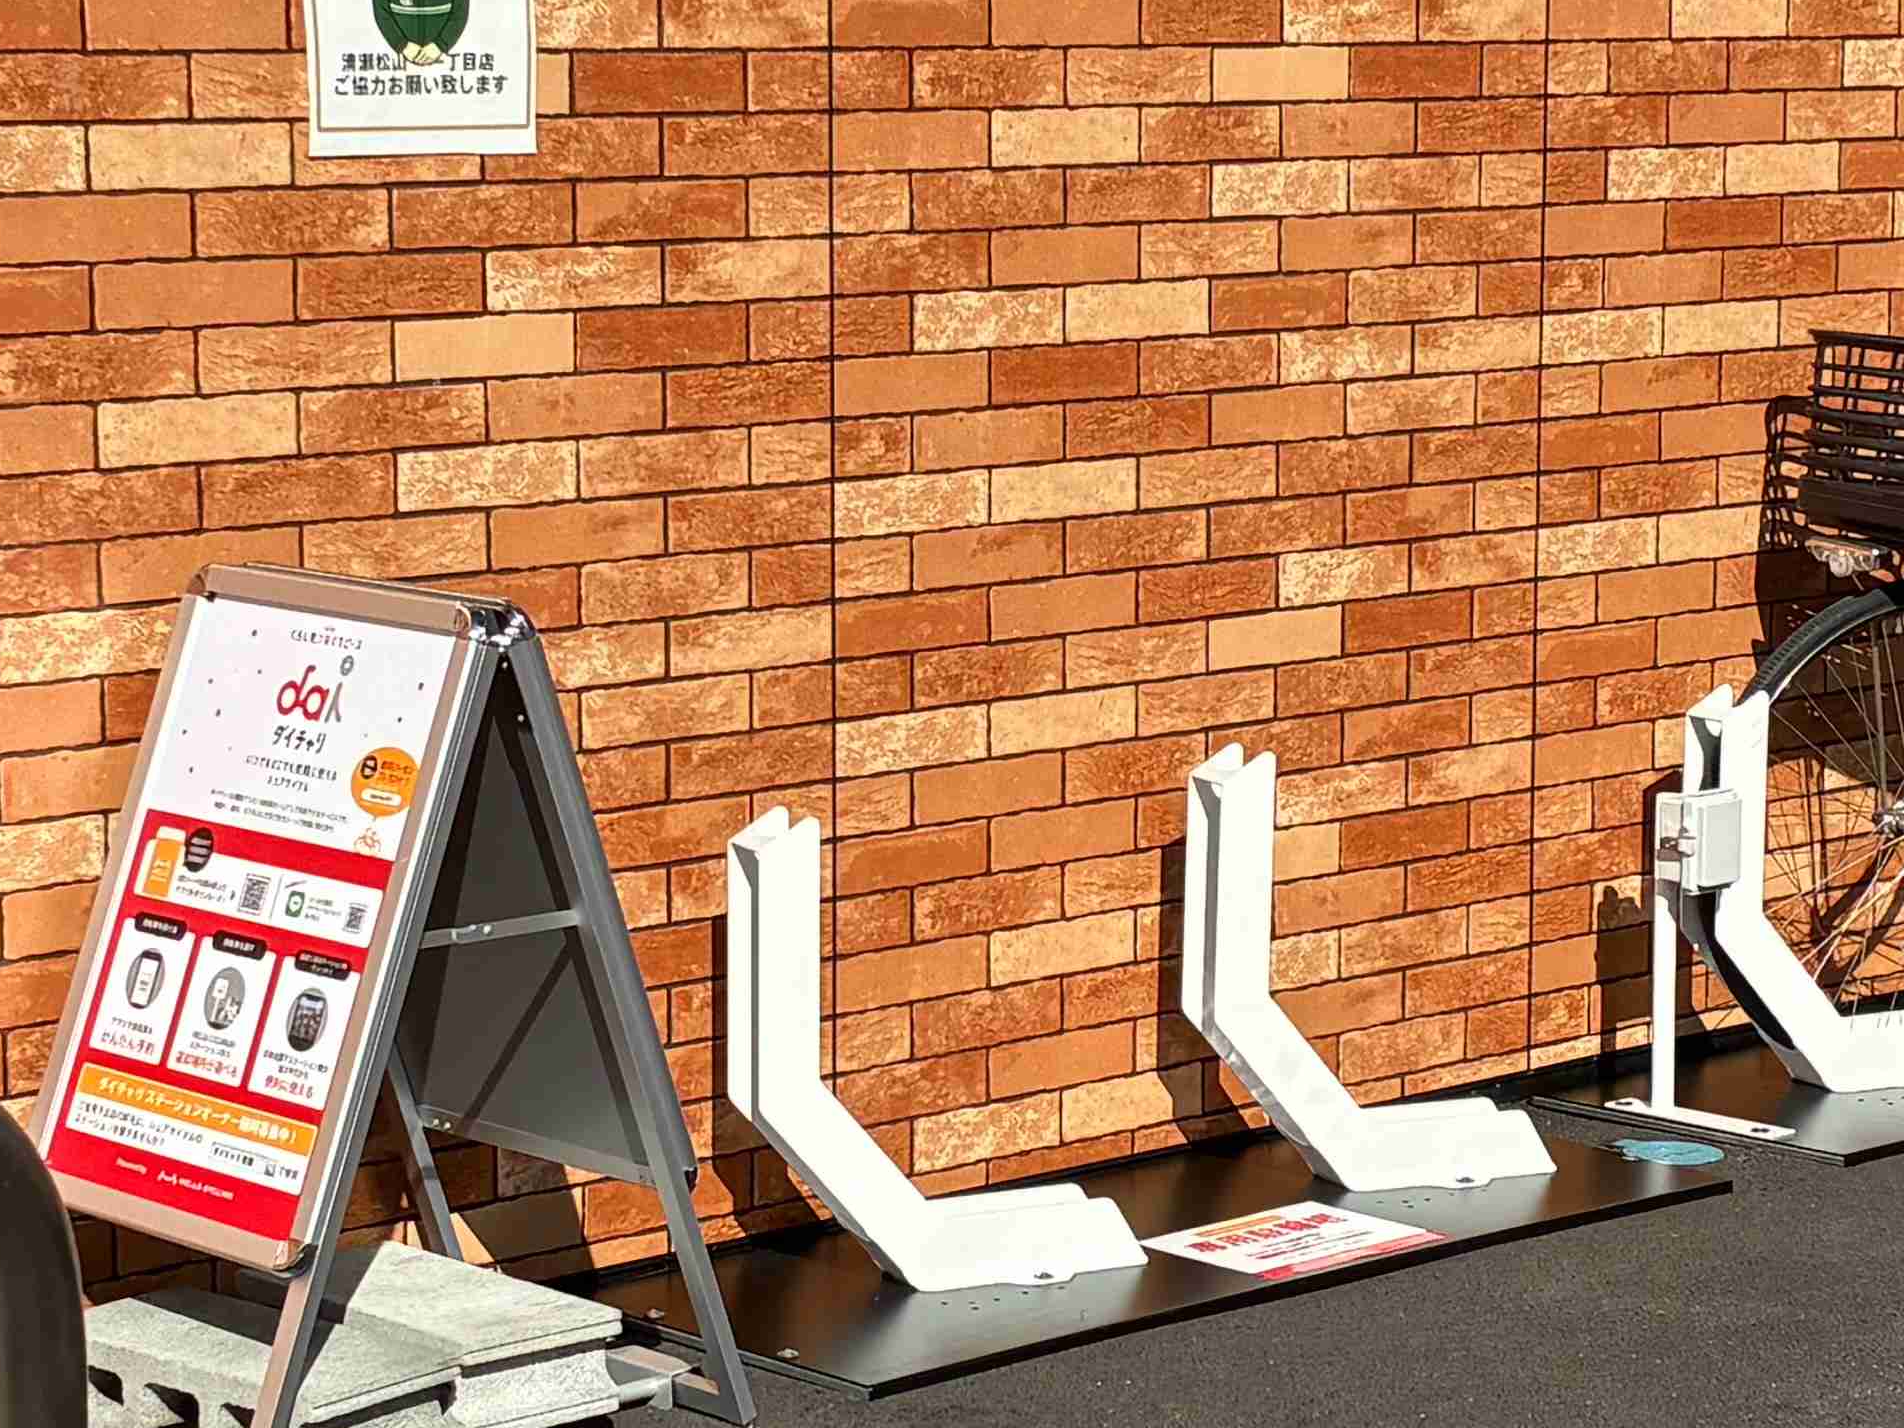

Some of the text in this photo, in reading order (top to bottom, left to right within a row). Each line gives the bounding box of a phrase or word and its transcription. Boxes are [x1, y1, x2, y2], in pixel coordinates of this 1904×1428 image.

[334, 74, 509, 97] ご協力お願い致します
[272, 724, 328, 754] ダイチャリ
